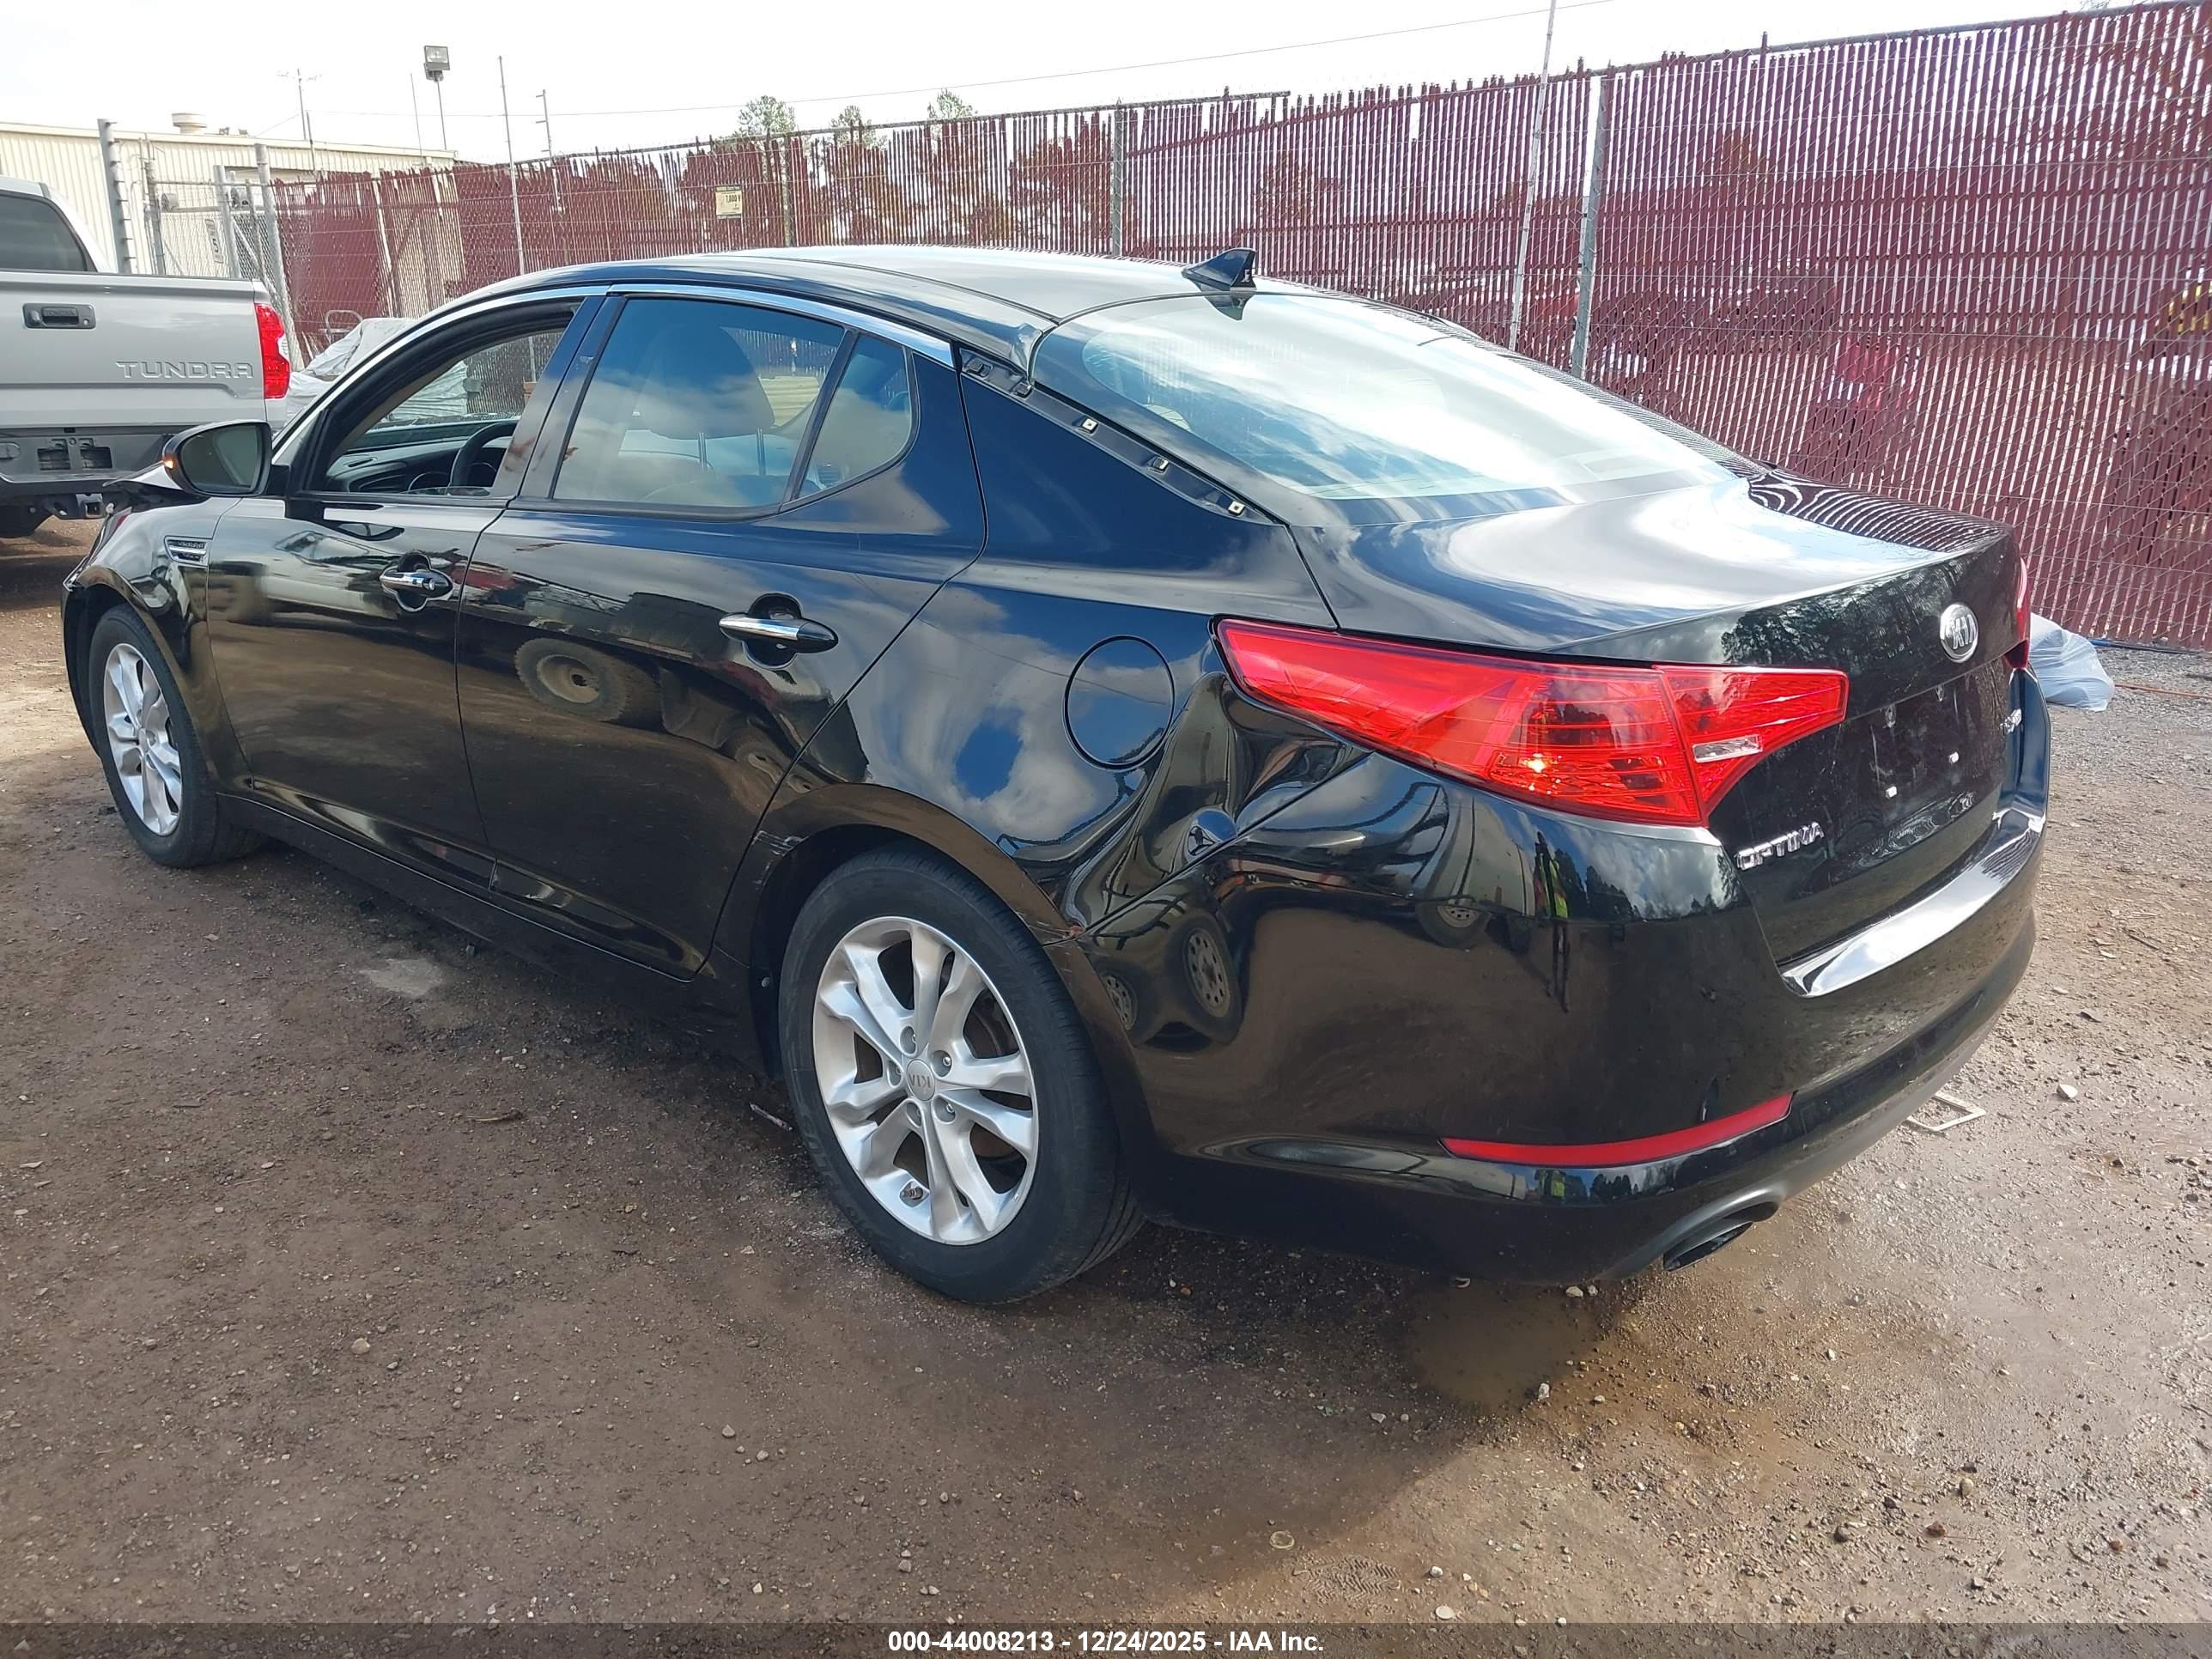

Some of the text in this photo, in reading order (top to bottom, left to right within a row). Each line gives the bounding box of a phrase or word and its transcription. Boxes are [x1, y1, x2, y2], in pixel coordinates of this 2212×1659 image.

[115, 361, 254, 379] TUNDRA
[1950, 613, 1978, 650] KIA
[1734, 821, 1825, 871] OPTIMA
[908, 1073, 932, 1088] KIA
